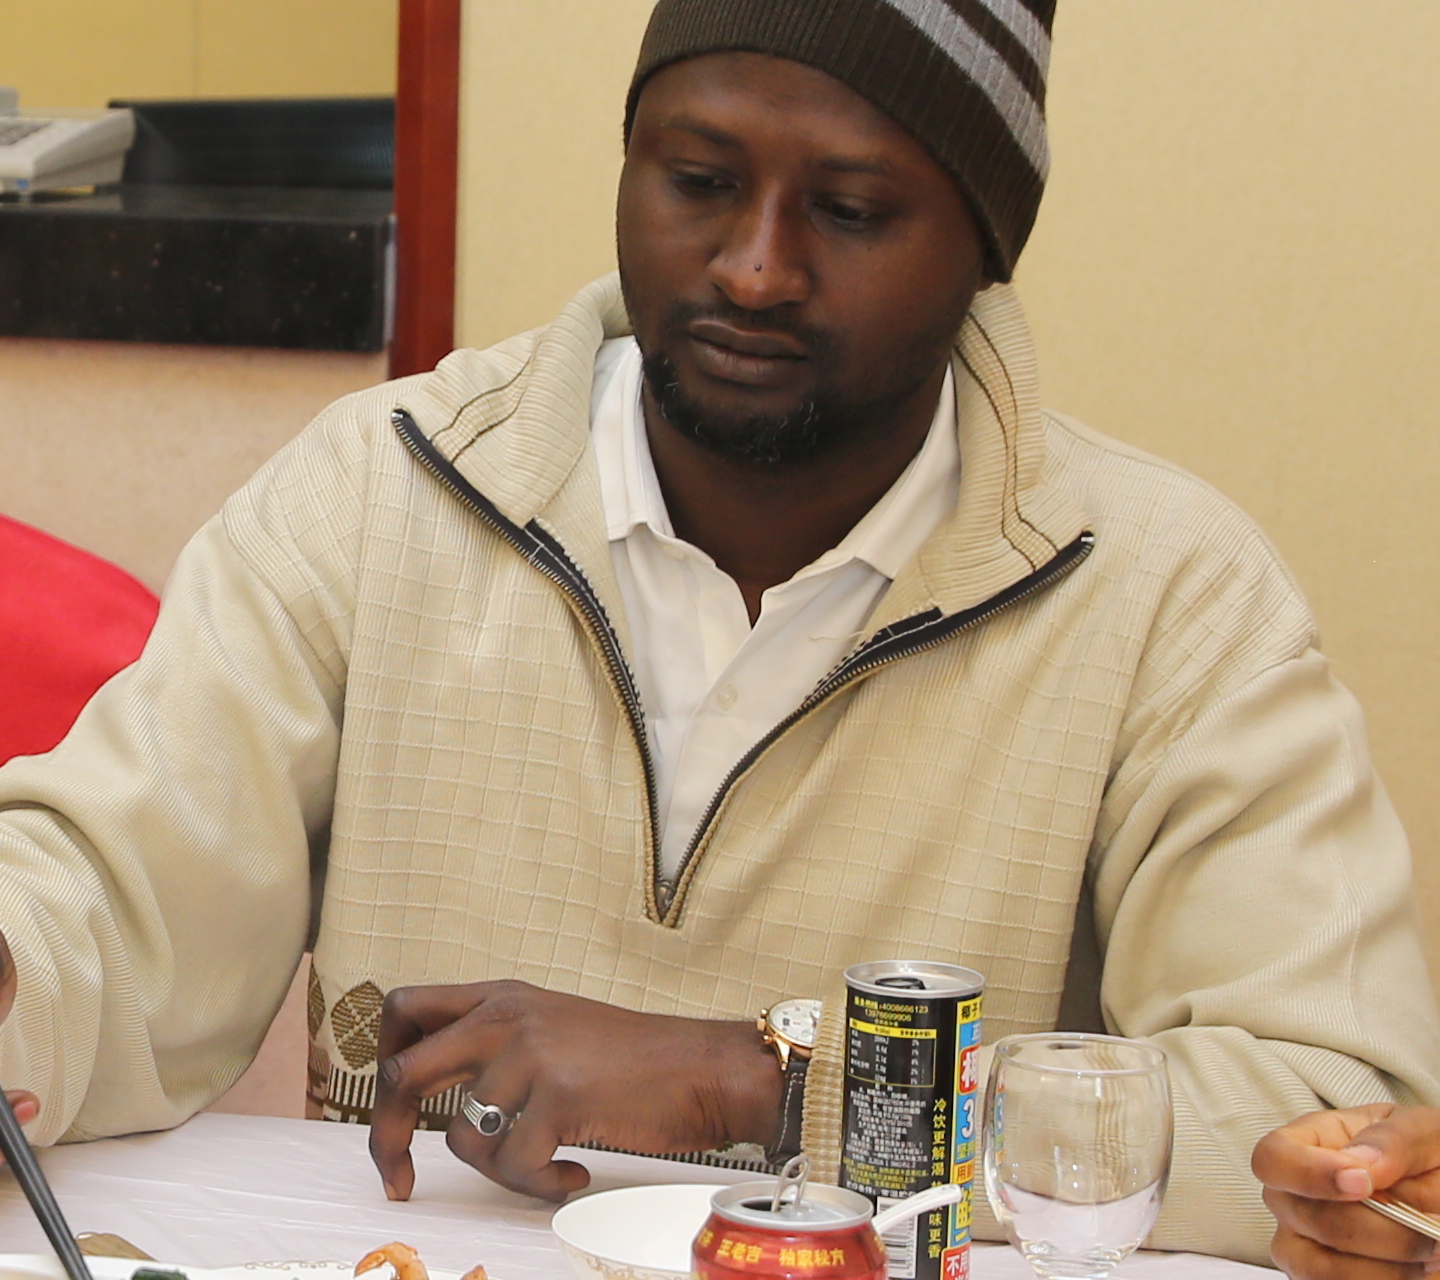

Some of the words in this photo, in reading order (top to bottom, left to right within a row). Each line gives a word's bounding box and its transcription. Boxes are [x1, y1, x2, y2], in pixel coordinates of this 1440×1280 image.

[931, 1097, 947, 1176] 冷饮更解渴
[717, 1238, 764, 1263] 王老吉
[779, 1247, 846, 1267] 独家秘方
